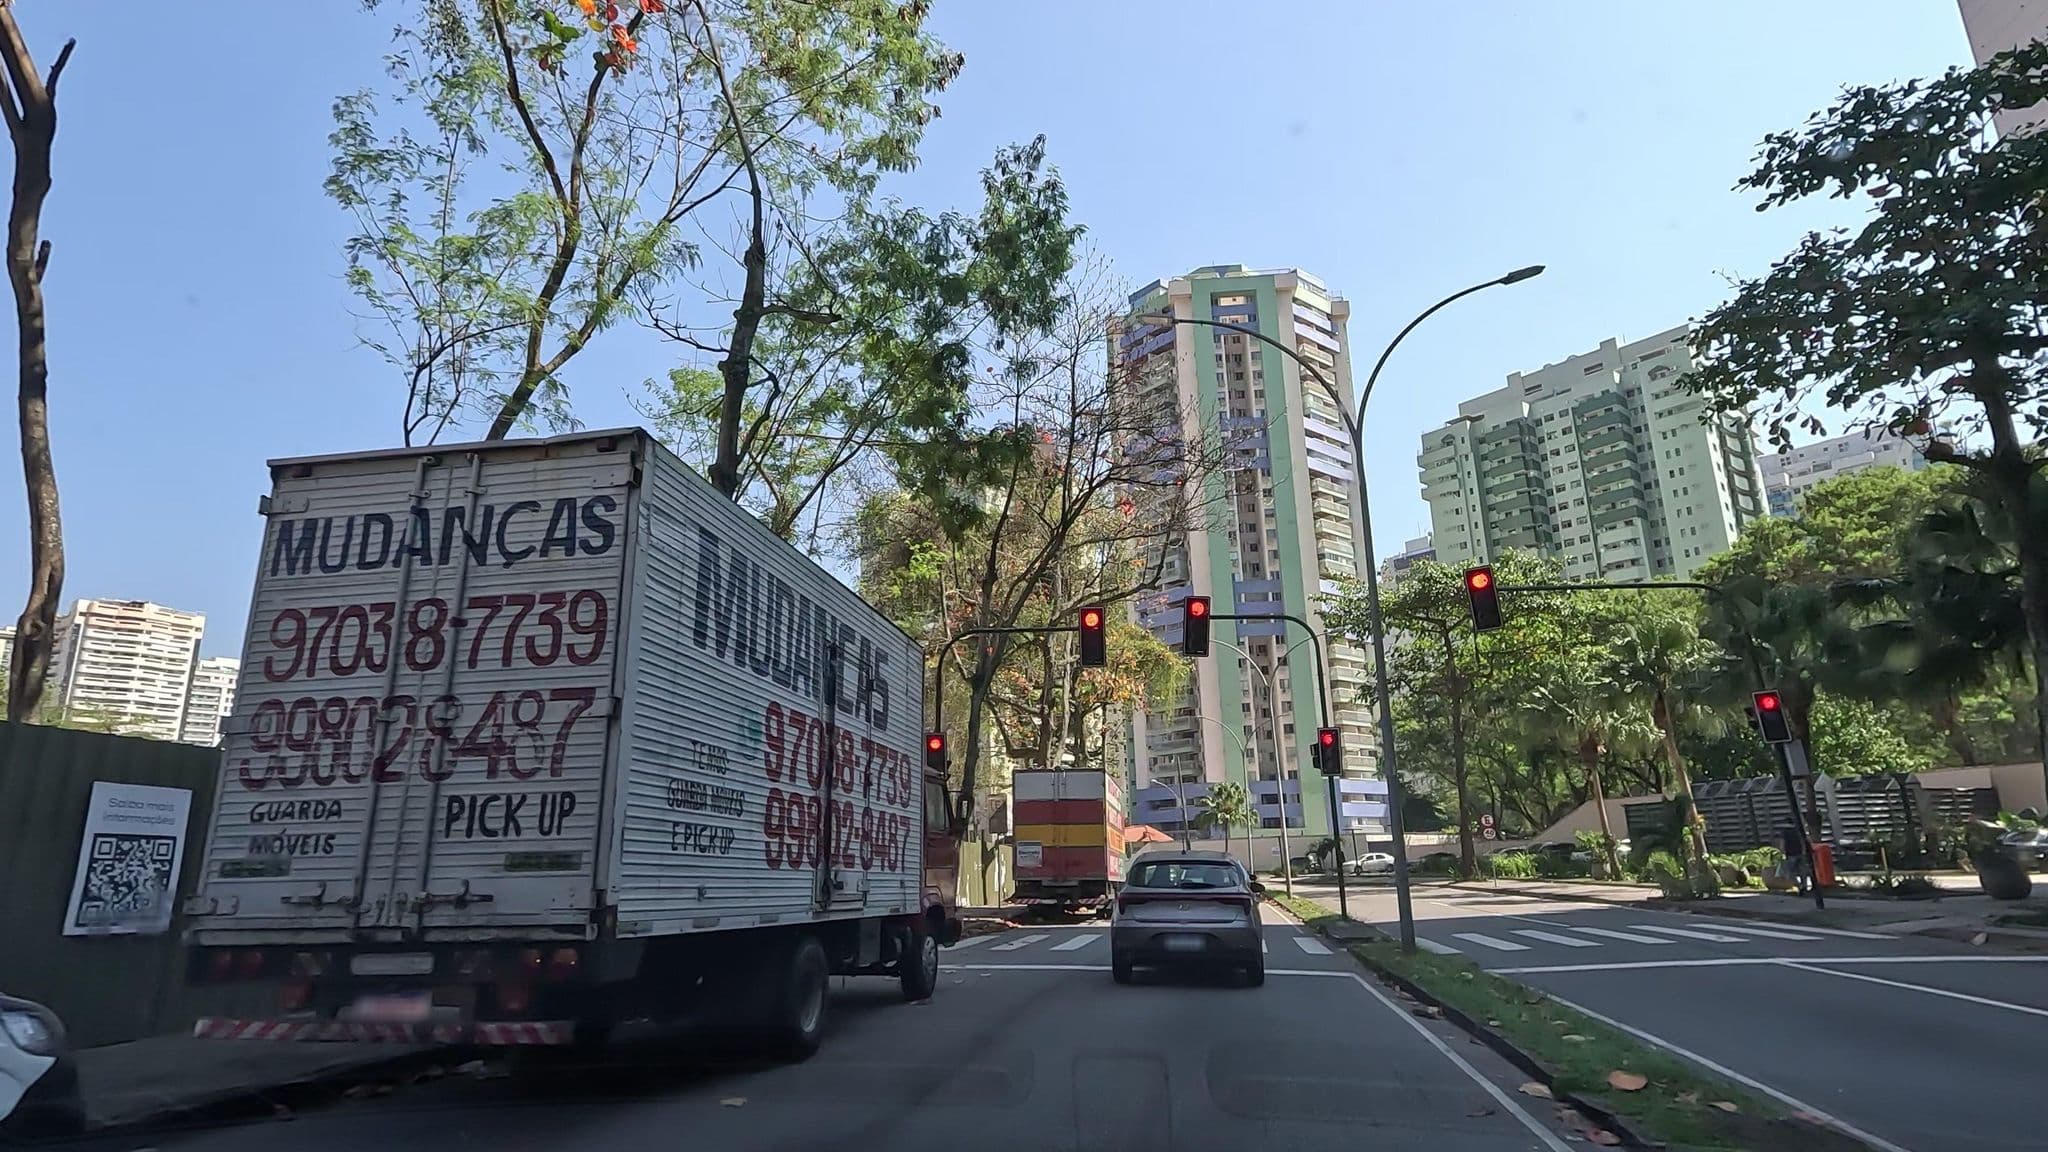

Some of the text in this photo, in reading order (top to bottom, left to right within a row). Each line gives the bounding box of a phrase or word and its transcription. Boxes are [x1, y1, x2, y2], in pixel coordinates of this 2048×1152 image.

[270, 495, 617, 577] MUDANÇAS
[690, 740, 729, 775] TEMOS
[250, 799, 342, 823] GUARDA
[667, 779, 708, 811] GUARDA
[445, 791, 576, 838] PICK UP
[249, 828, 337, 855] MÓVEIS
[683, 823, 717, 854] PICK
[720, 827, 735, 855] UP
